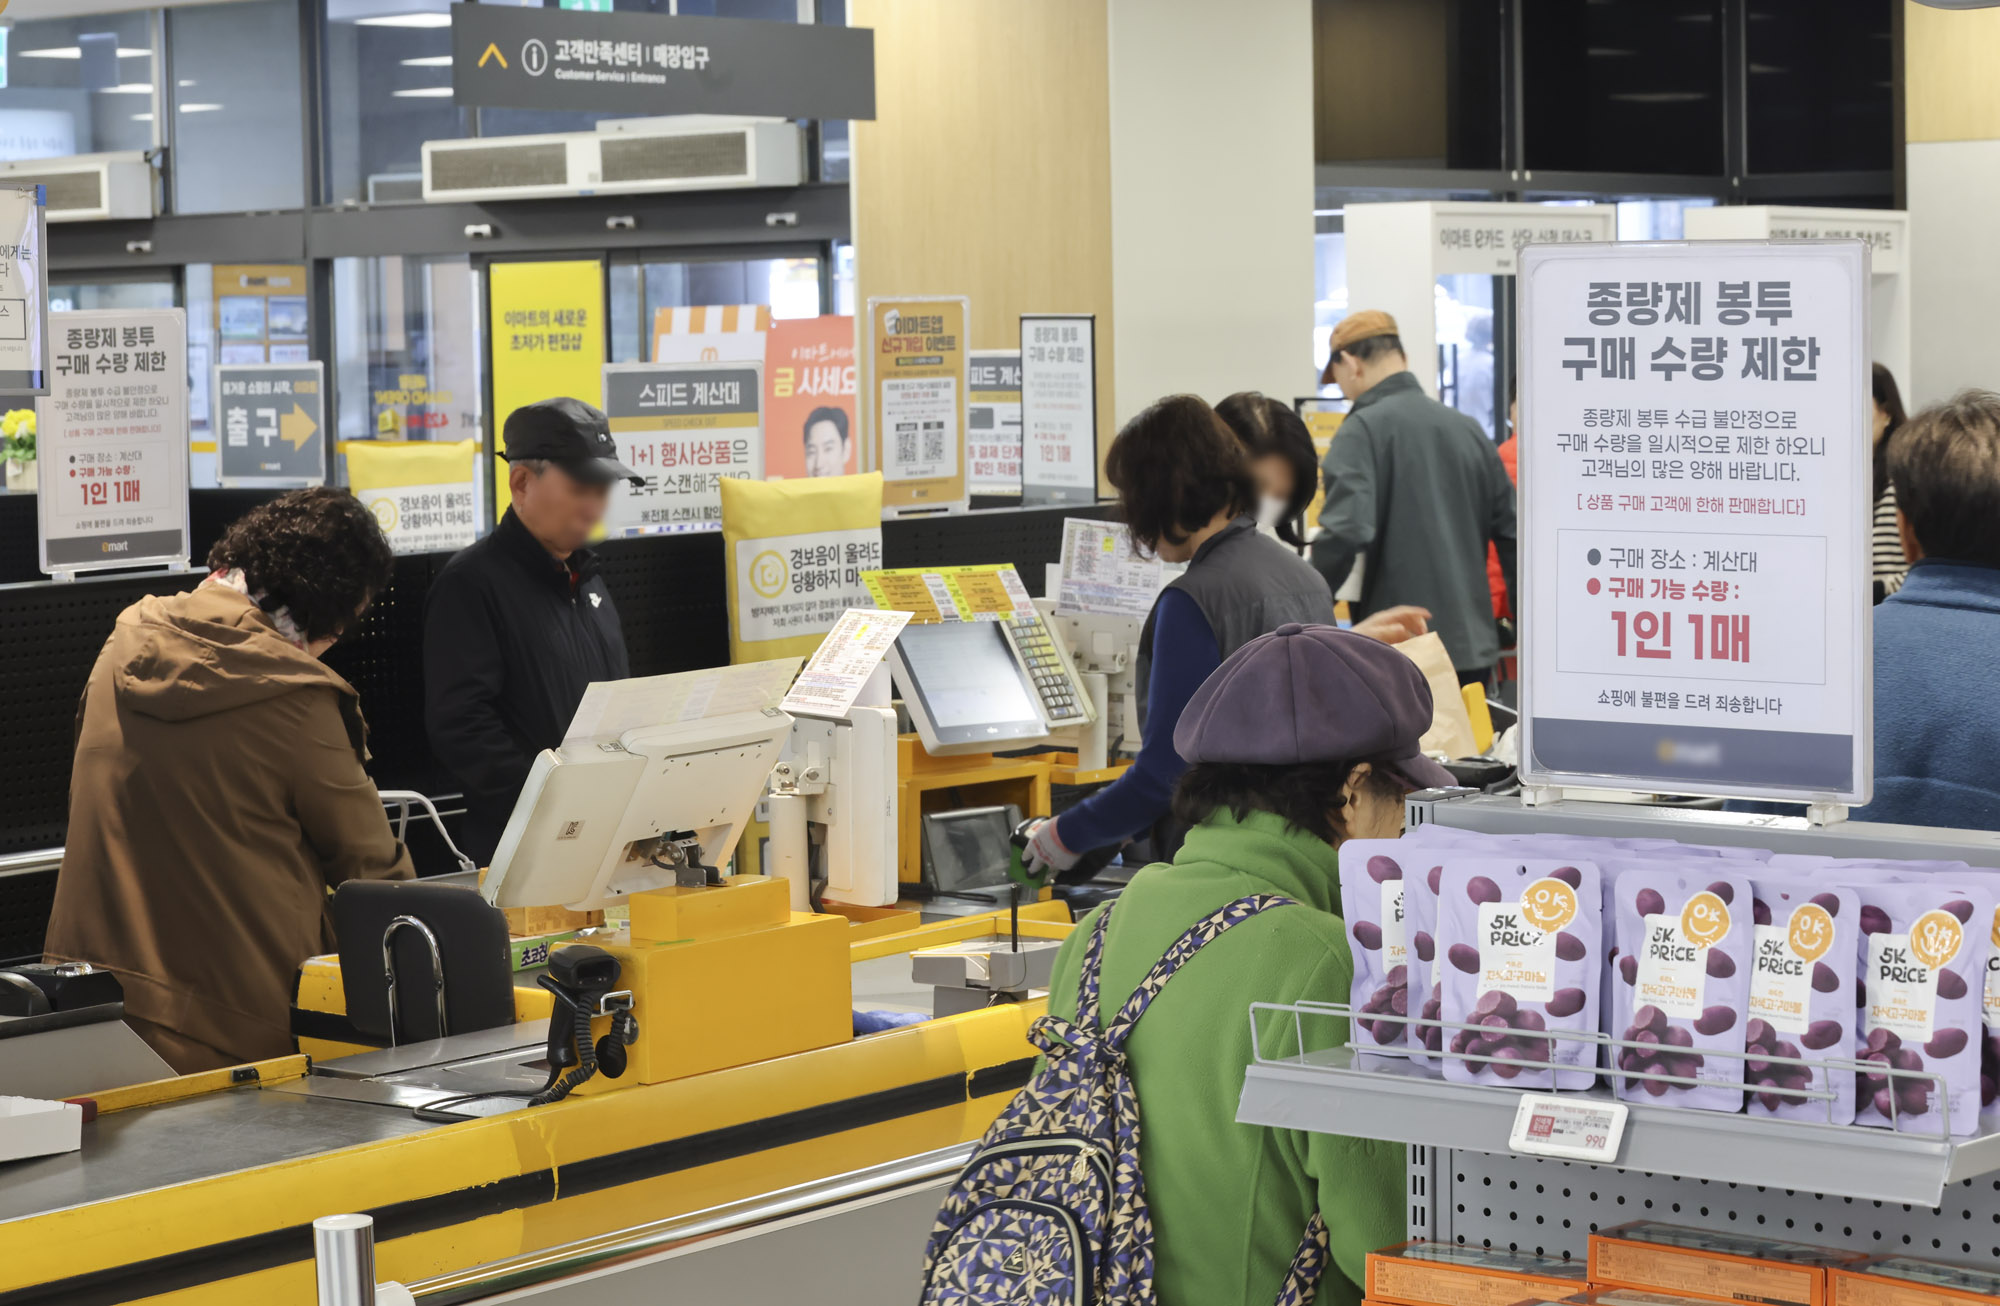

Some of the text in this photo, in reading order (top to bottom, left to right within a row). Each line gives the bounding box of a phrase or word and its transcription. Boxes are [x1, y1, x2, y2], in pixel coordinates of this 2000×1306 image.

[555, 39, 709, 69] 고객만족센터 매장입구
[554, 68, 666, 84] Customer Service Entrance
[1587, 281, 1793, 326] 종량제 봉투
[504, 308, 586, 328] 이마트의 새로운
[895, 315, 943, 334] 이마트앱
[67, 326, 155, 350] 종량제 봉투
[511, 334, 544, 351] 초저가
[882, 336, 923, 353] 신규가입
[56, 351, 166, 376] 구매 수량 제한
[1562, 336, 1821, 381] 구매 수량 제한
[797, 366, 856, 396] 사세요
[639, 381, 740, 407] 스피드 계산대
[1583, 409, 1797, 430] 종량제 봉투 수급 불안정으로
[631, 439, 749, 467] 1+1 행사상품은
[1556, 433, 1825, 456] 구매 수량을 일시적으로 제한 하오니
[1581, 459, 1801, 482] 고객님의 많은 양해 바랍니다.
[81, 480, 140, 505] 1인 1매
[672, 507, 700, 521] 스캔시
[1586, 494, 1806, 516] 상품 구매 고객에 한해 판매합니다]
[102, 541, 128, 552] emart
[791, 542, 880, 569] 경보음이 울려도
[1608, 548, 1758, 573] 구매 장소 계산대
[792, 568, 841, 593] 당황하지
[1608, 577, 1728, 602] 구매 가능 수량
[1611, 611, 1750, 663] 1인 1매
[1597, 689, 1783, 715] 쇼핑에 불편을 드려 죄송합니다
[1490, 914, 1517, 929] 5K
[1801, 915, 1825, 934] OK
[1759, 939, 1784, 956] 5K
[1879, 947, 1906, 964] 5K
[1585, 1134, 1607, 1150] 990
